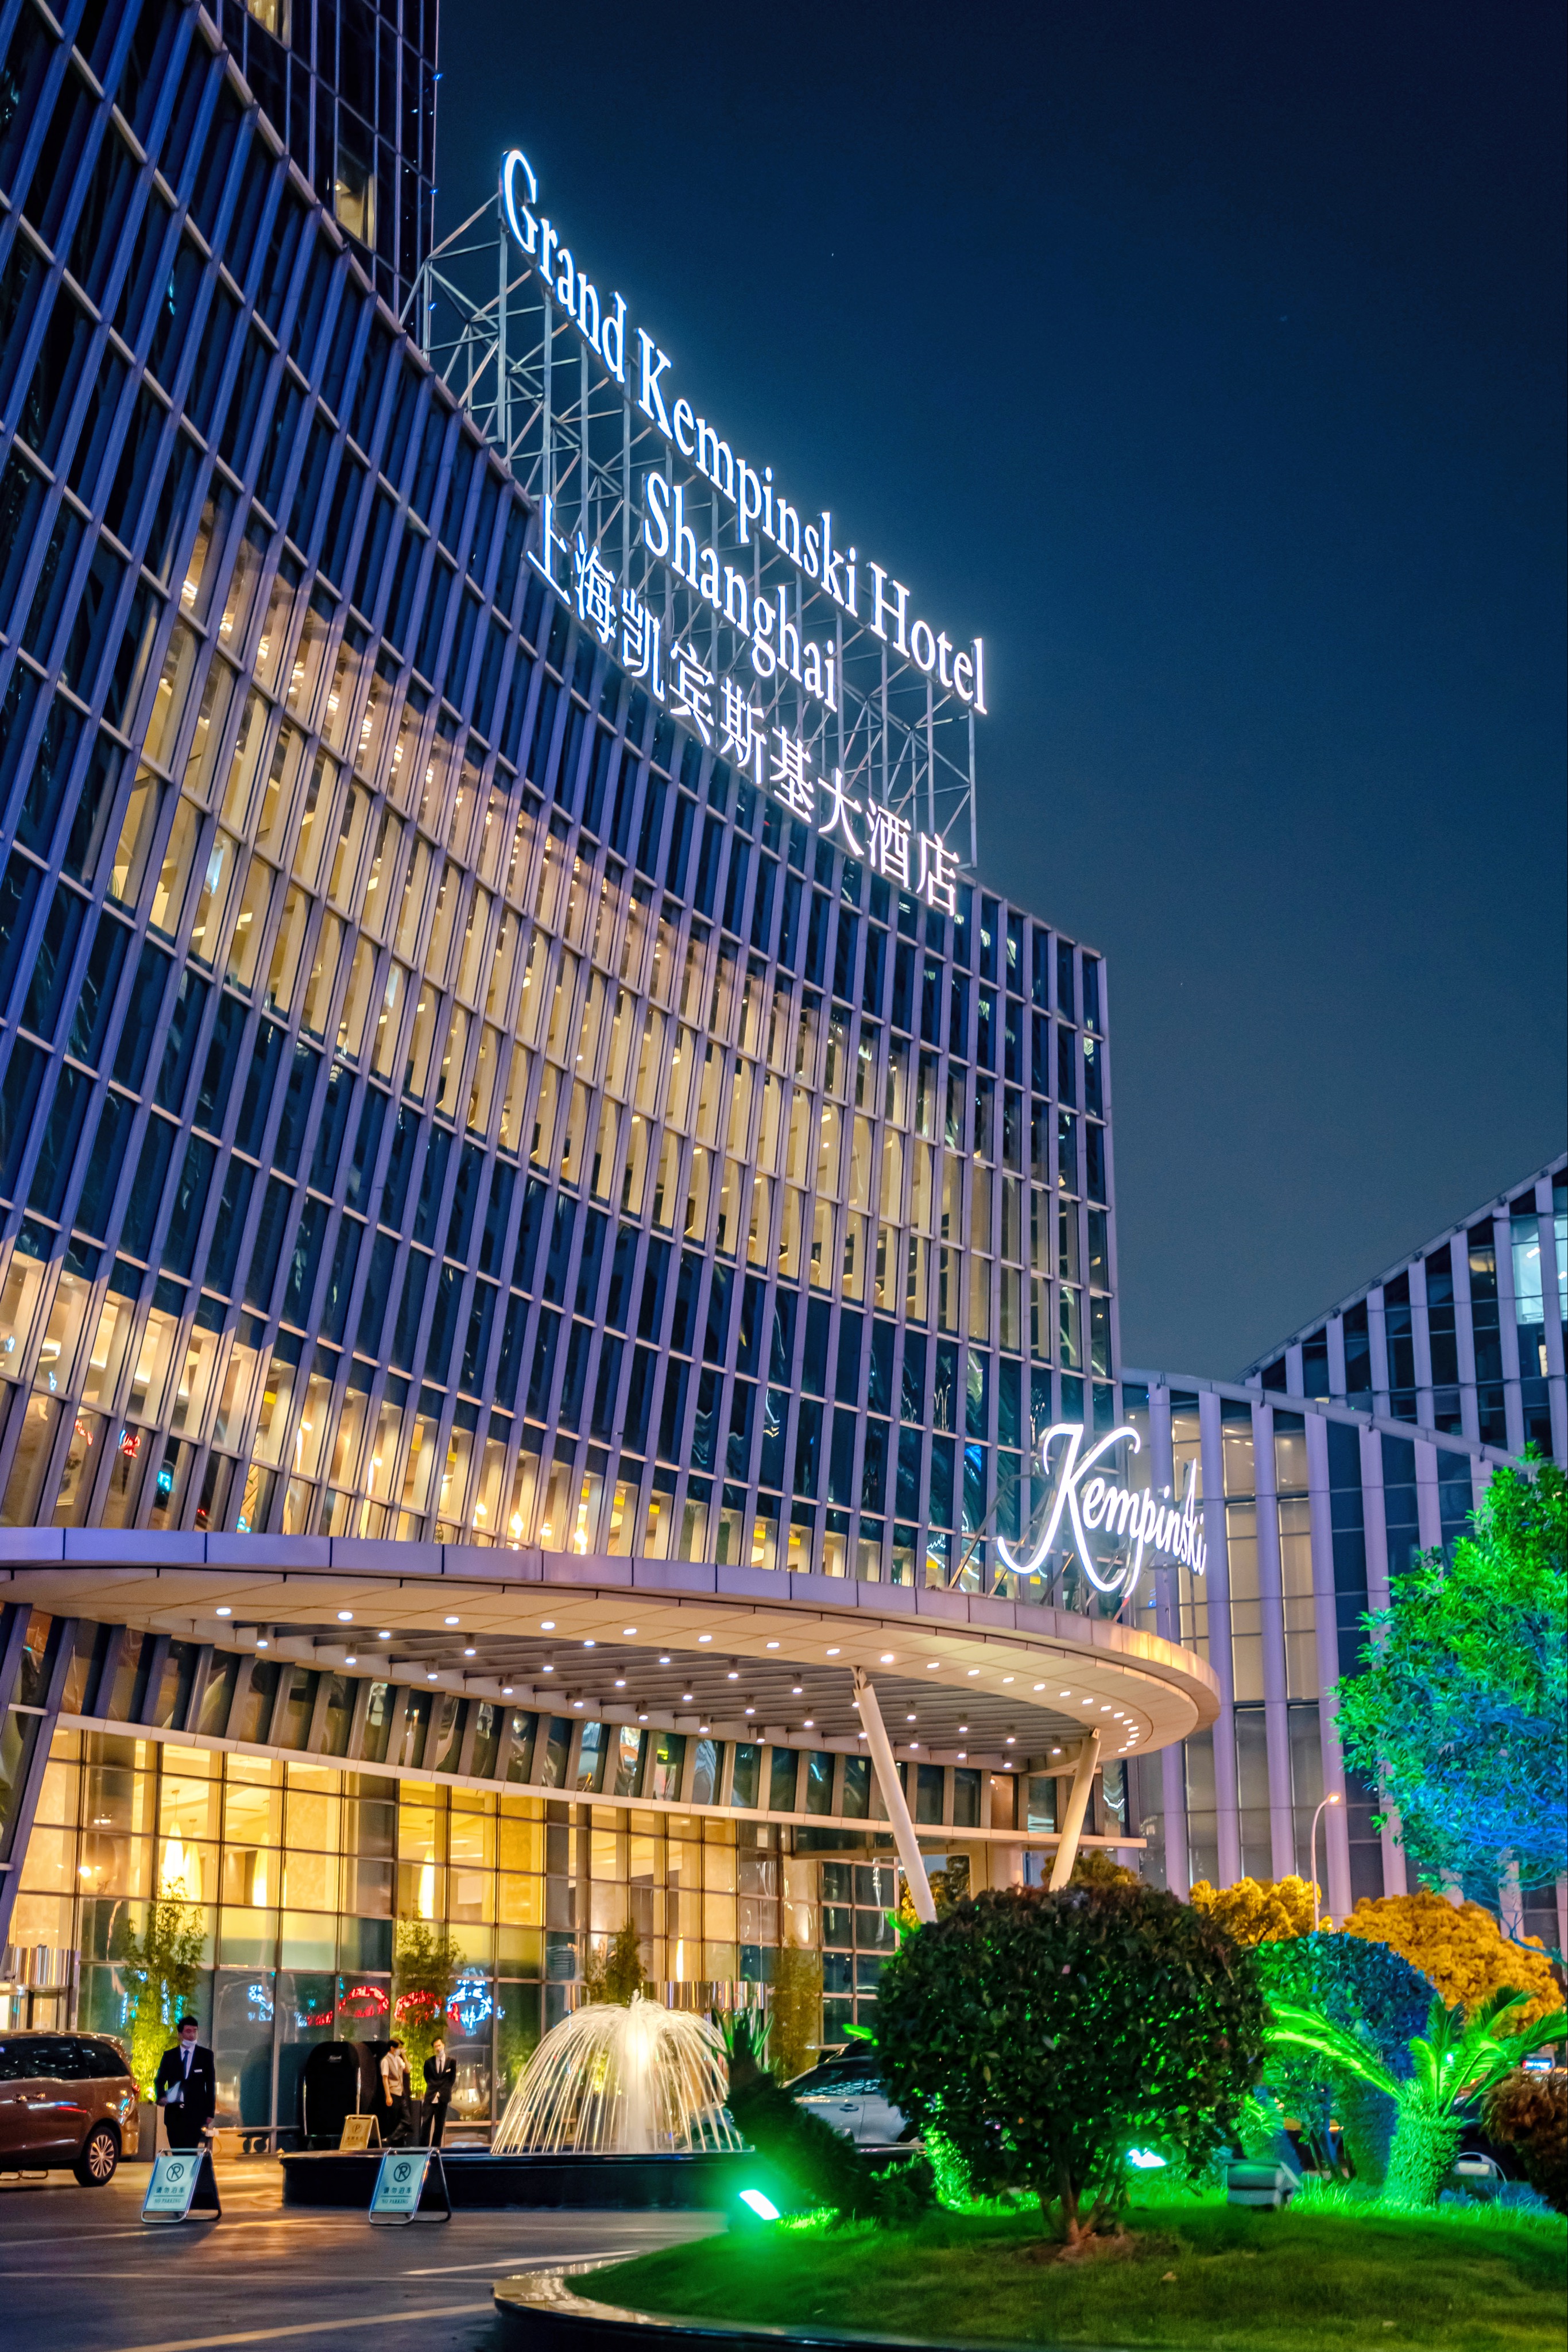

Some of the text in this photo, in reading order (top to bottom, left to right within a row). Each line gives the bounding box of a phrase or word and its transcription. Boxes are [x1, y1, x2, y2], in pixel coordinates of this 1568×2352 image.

[502, 149, 989, 717] Grand Kempinski Hotel
[642, 471, 839, 714] Shanghai
[525, 492, 962, 918] 上海凯宾斯基大酒店
[996, 1422, 1207, 1599] Kempinski
